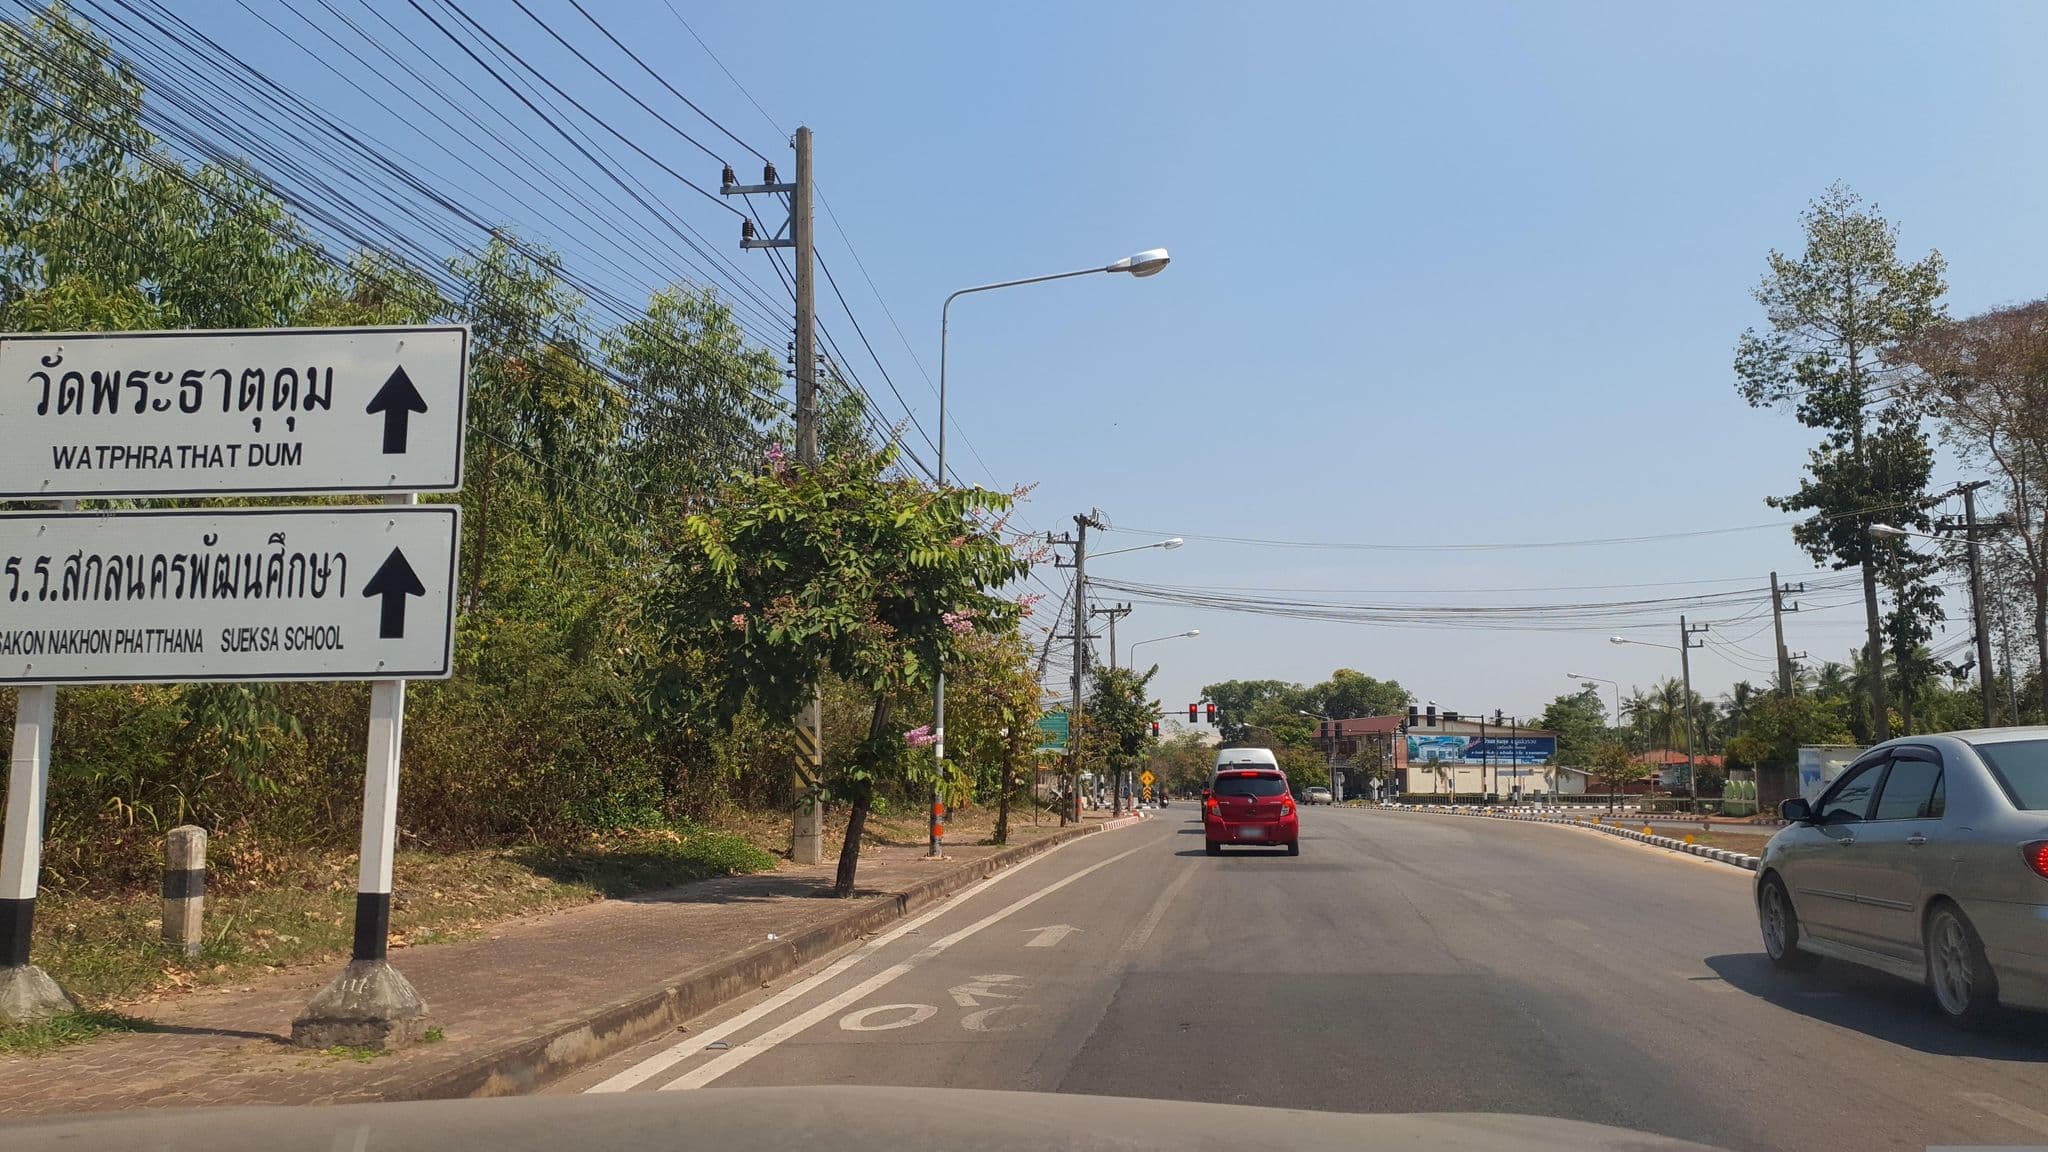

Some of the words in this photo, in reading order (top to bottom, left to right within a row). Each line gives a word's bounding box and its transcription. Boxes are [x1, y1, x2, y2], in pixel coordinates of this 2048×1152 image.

[29, 355, 334, 434] วัดพระธาตุดุม
[247, 442, 303, 467] DUM
[4, 531, 347, 603] ร.ร.สกลนครพัฒนศึกษา
[47, 629, 113, 655] NAKHON
[114, 628, 204, 654] PHATTHANA
[220, 626, 279, 653] SUEKSA
[283, 625, 344, 651] SCHOOL
